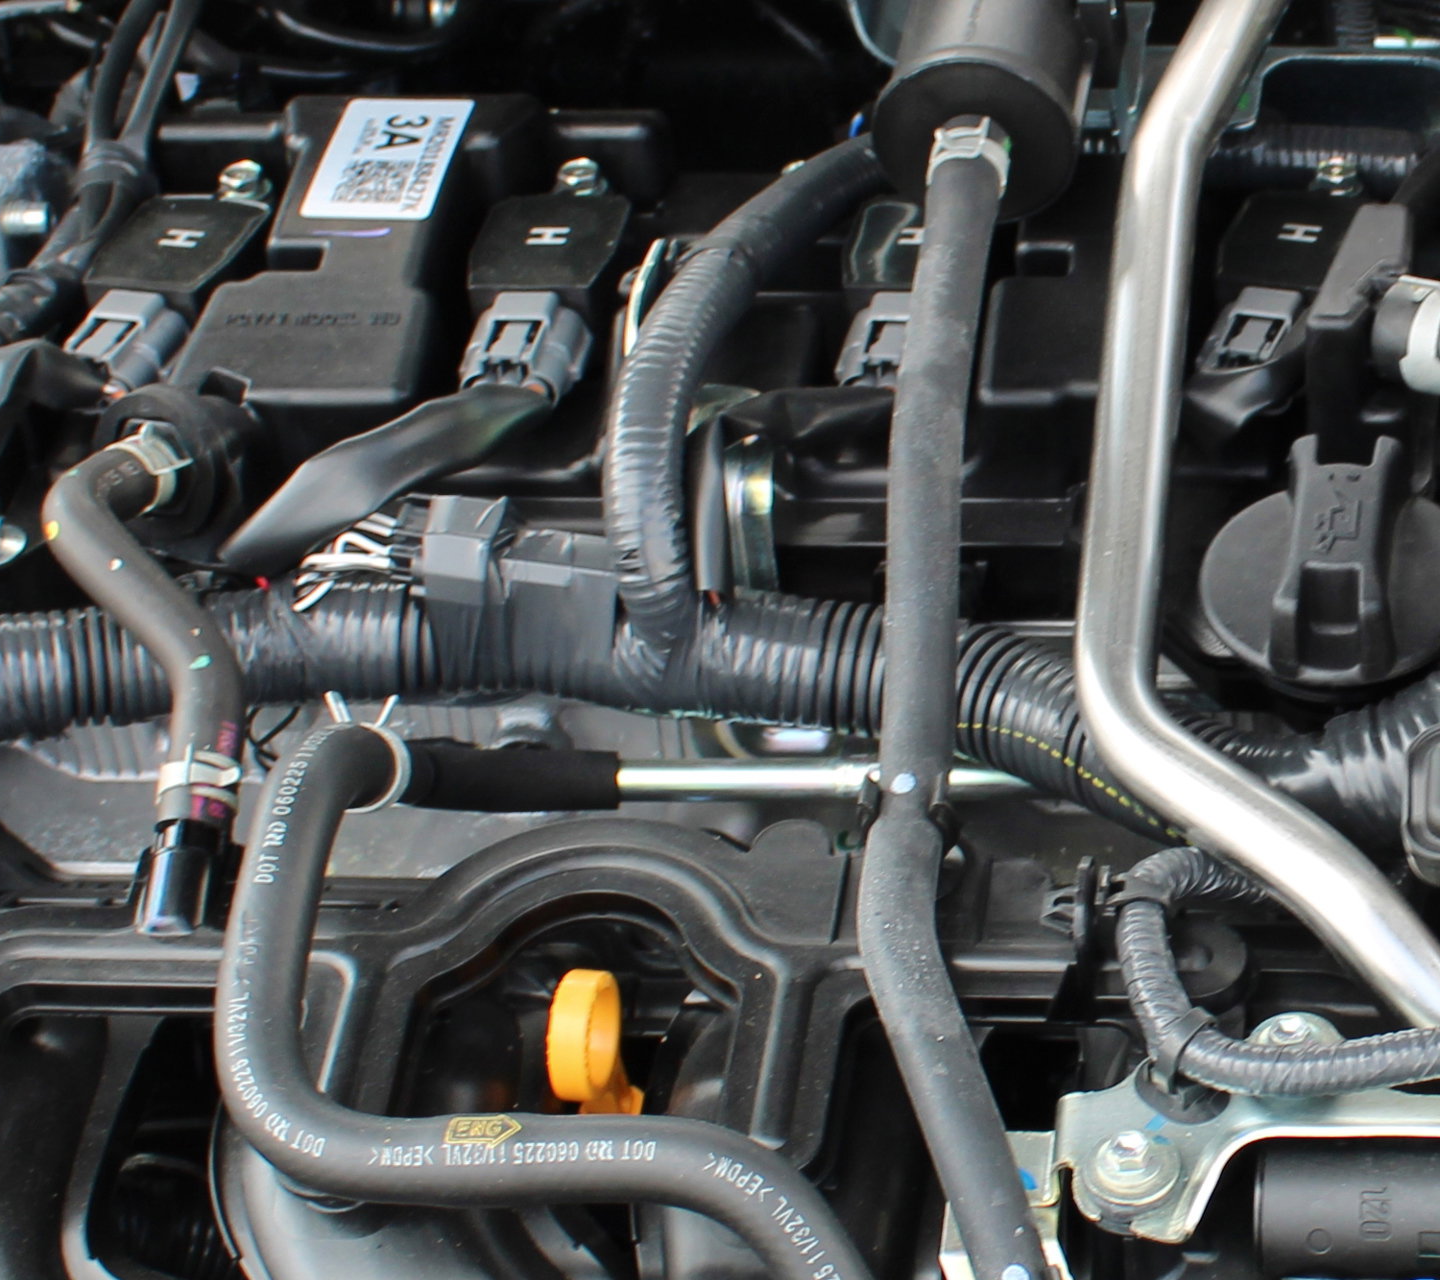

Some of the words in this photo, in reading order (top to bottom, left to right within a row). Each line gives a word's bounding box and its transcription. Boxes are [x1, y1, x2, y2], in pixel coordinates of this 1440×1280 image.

[373, 115, 430, 150] 3A
[253, 854, 280, 884] DOT
[272, 760, 309, 816] 060225
[456, 1120, 502, 1137] ENG
[291, 1130, 326, 1157] DOT
[513, 1141, 579, 1164] 060225
[621, 1141, 656, 1161] DOT
